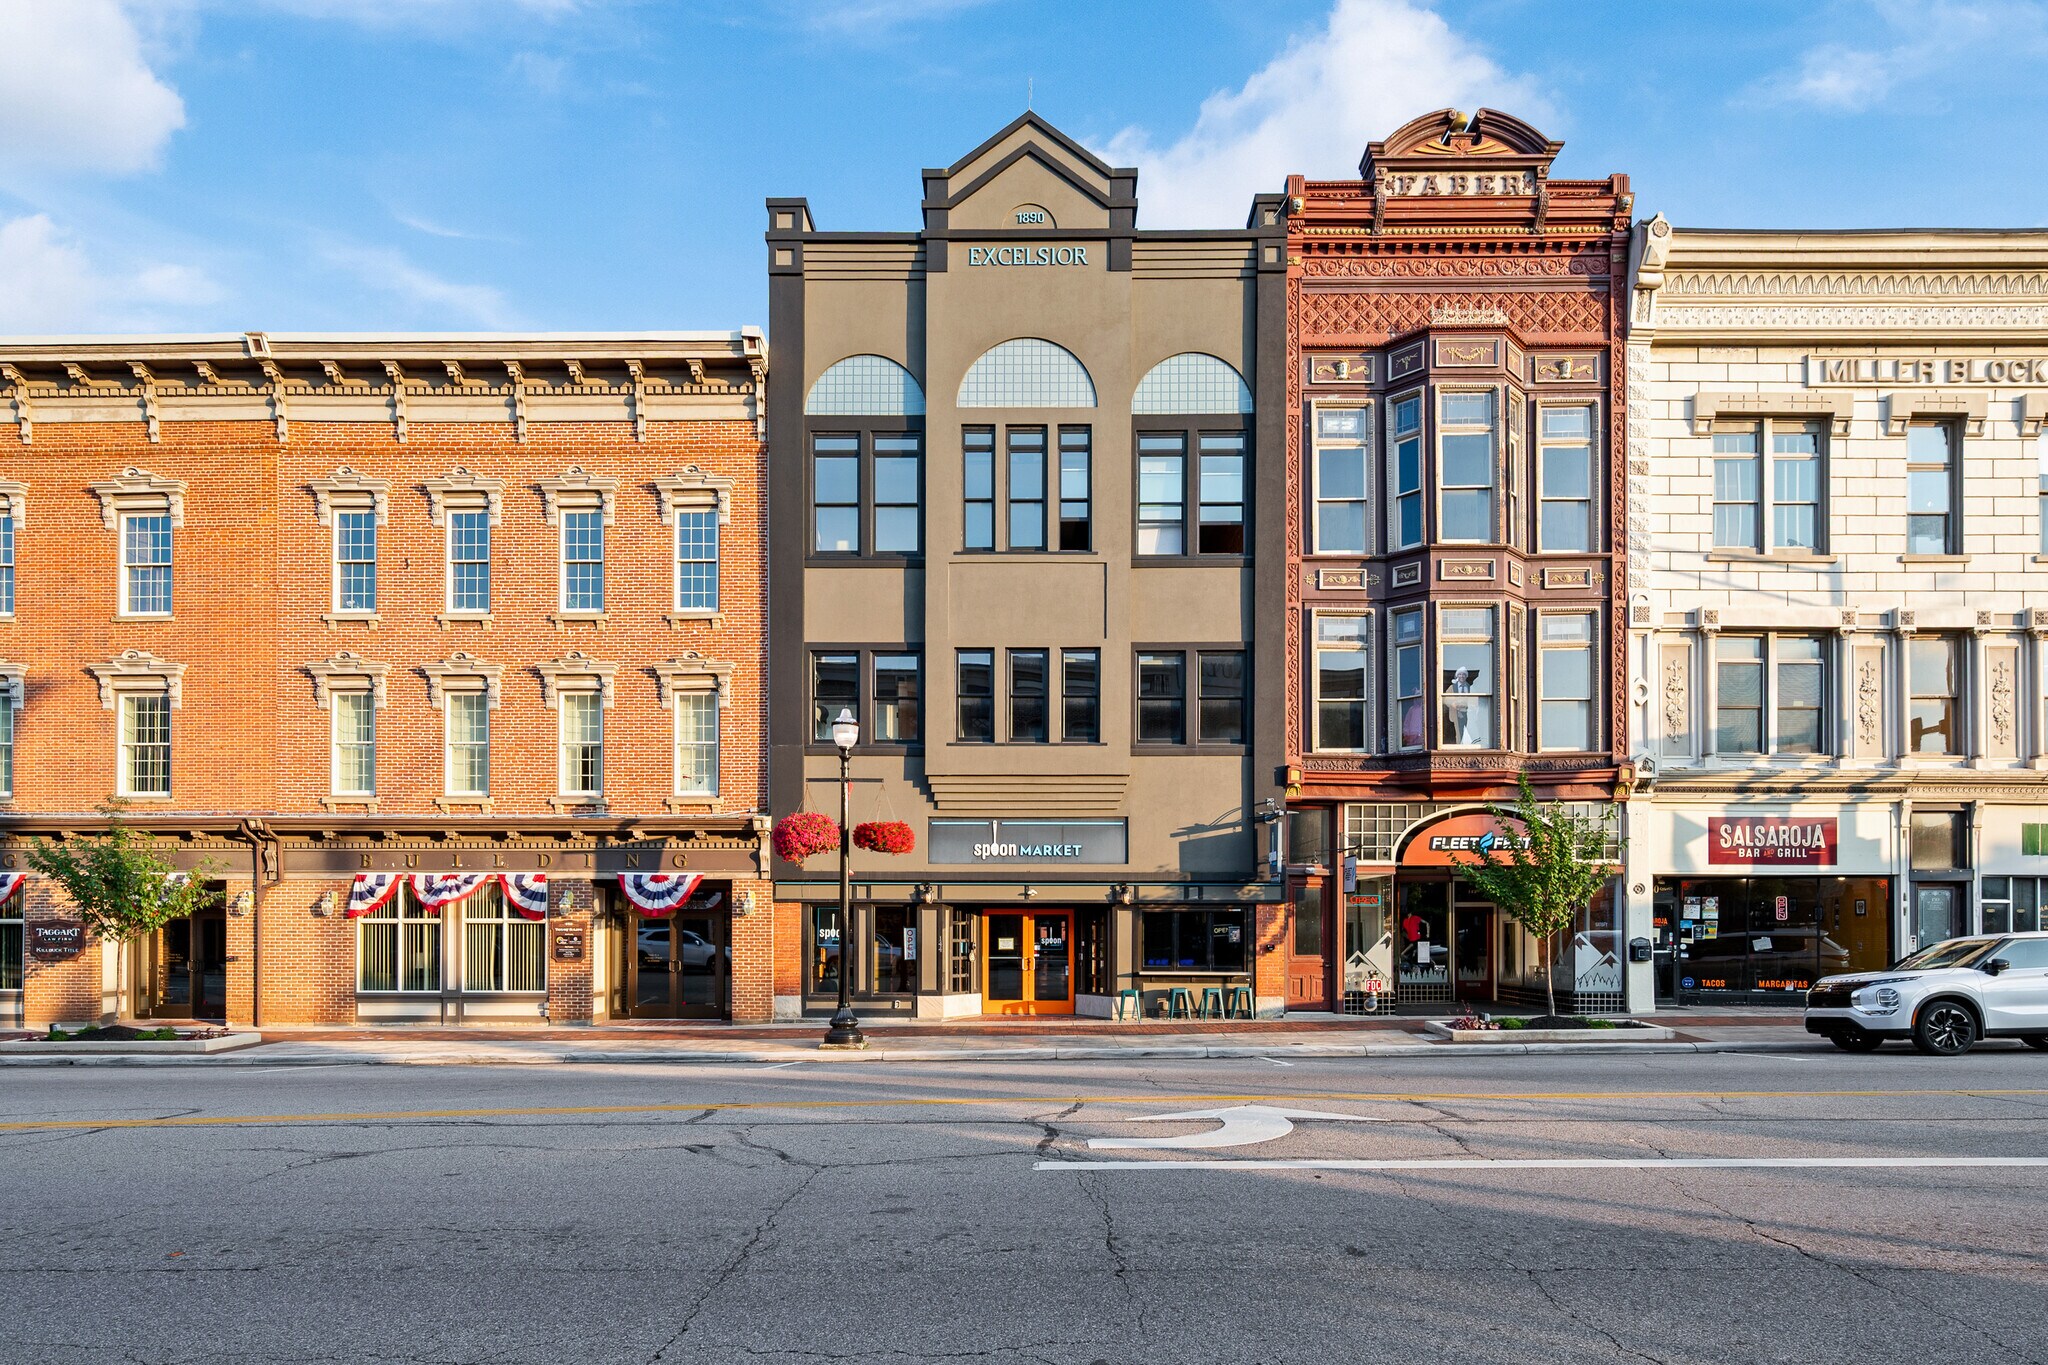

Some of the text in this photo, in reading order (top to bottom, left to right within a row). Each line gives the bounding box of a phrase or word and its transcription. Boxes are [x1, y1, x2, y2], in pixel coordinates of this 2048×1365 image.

[1398, 174, 1521, 195] FABER
[1016, 211, 1045, 223] 1890
[969, 246, 1089, 266] EXCELSIOR
[1821, 358, 2048, 382] MILLER BLOCK
[1431, 837, 1481, 850] FLEET
[1719, 823, 1827, 848] SALSAROJA
[973, 830, 1082, 860] spoon MARKET
[1738, 848, 1808, 858] BAR AND GRILL
[36, 927, 81, 937] TAGGART
[906, 929, 914, 959] OPEN
[1366, 980, 1381, 990] FDC
[1701, 979, 1726, 988] TACOS
